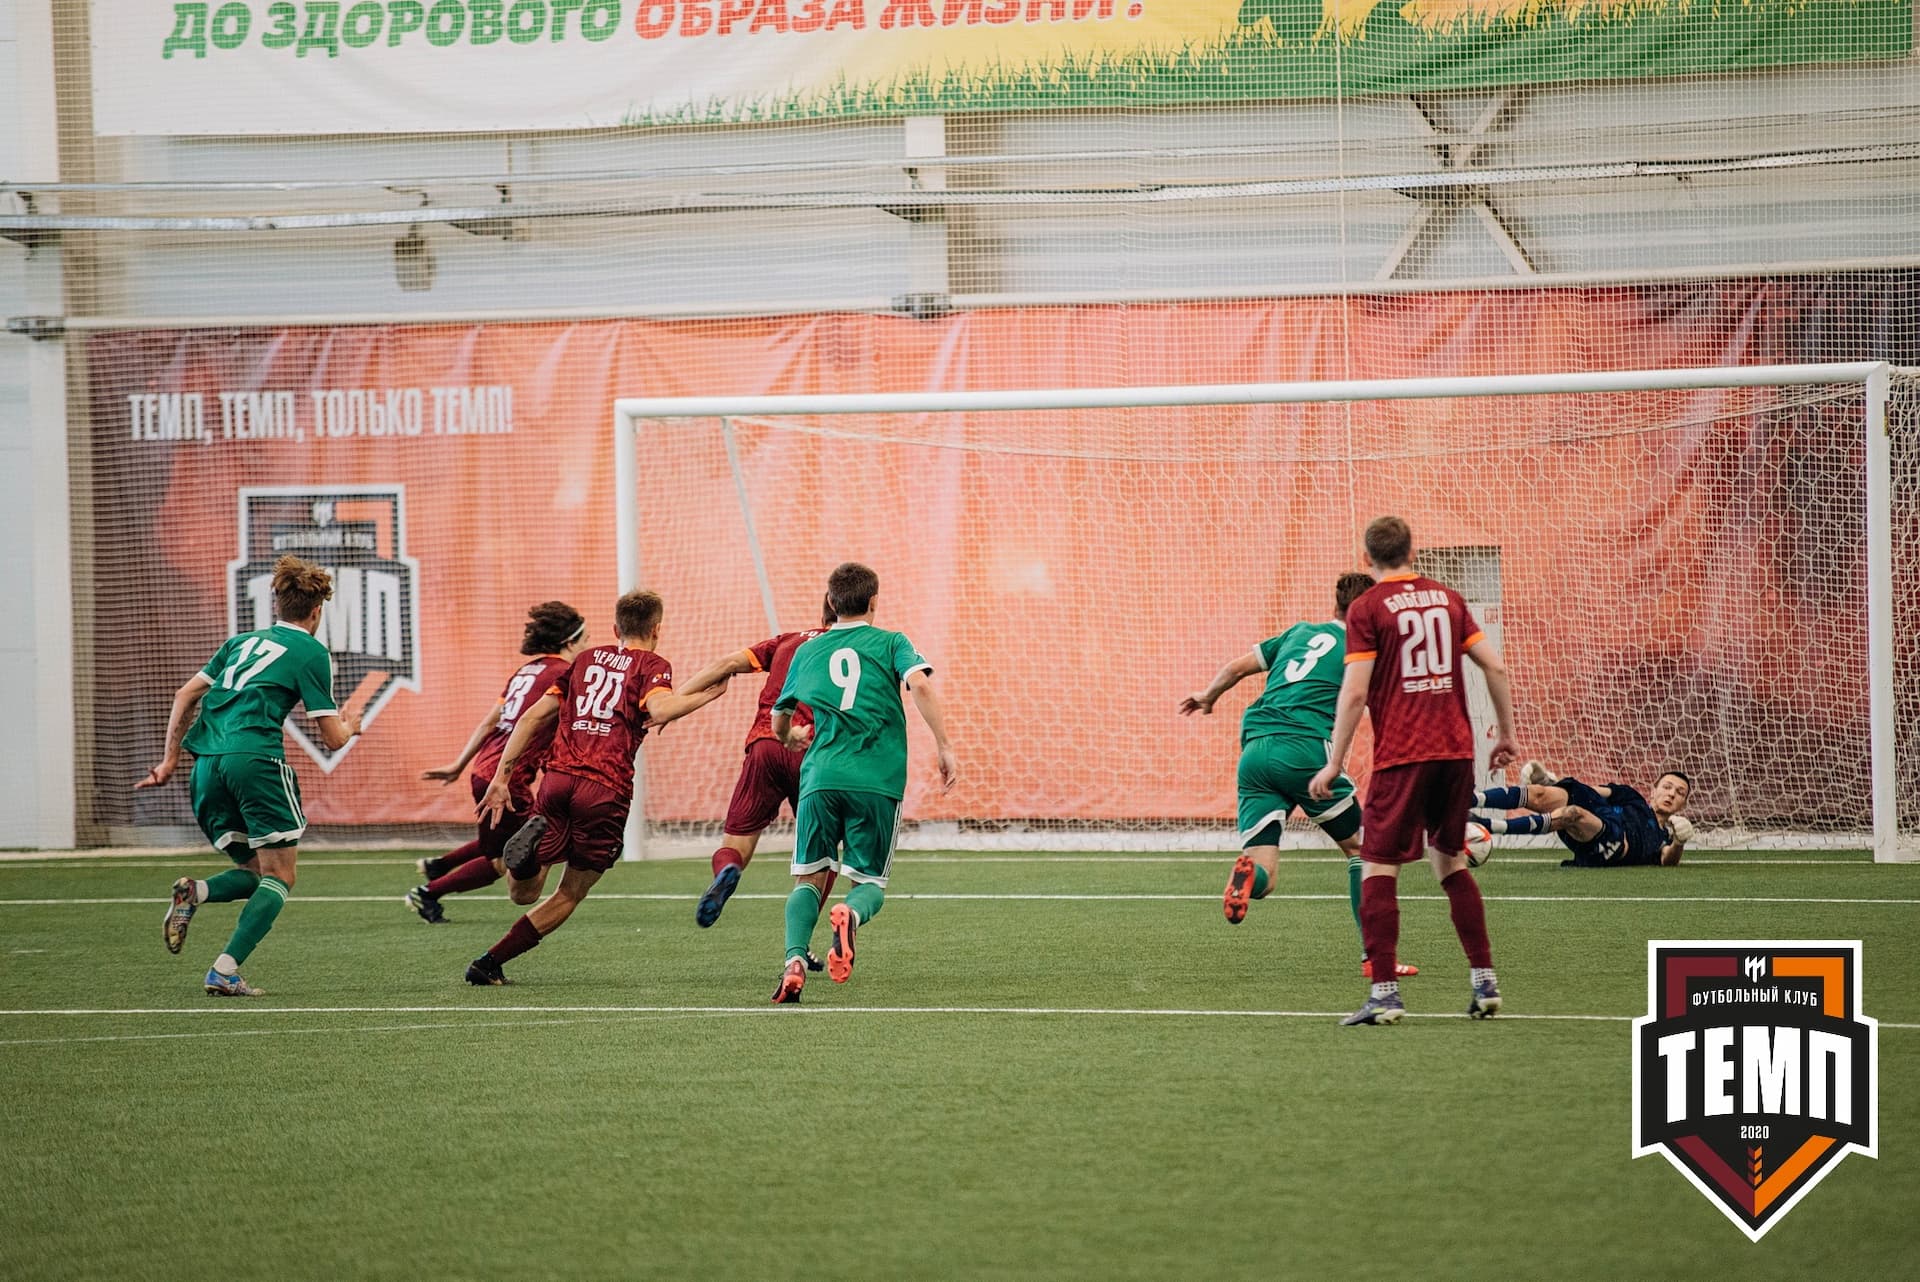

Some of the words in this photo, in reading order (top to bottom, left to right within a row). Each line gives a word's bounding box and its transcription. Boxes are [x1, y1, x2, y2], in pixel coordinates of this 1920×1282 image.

[163, 2, 251, 59] ДО
[261, 0, 622, 58] ЗДОРОВОГО
[634, 0, 867, 39] ОБРАЗА
[127, 394, 213, 445] ТЕМП,
[218, 391, 305, 443] ТЕМП,
[311, 387, 423, 437] ТОЛЬКО
[431, 385, 513, 435] ТЕМП!
[248, 566, 402, 662] ТМП
[1397, 606, 1453, 678] 20
[222, 636, 289, 692] 17
[829, 647, 861, 712] 9
[1284, 632, 1337, 682] 3
[575, 664, 625, 719] 30
